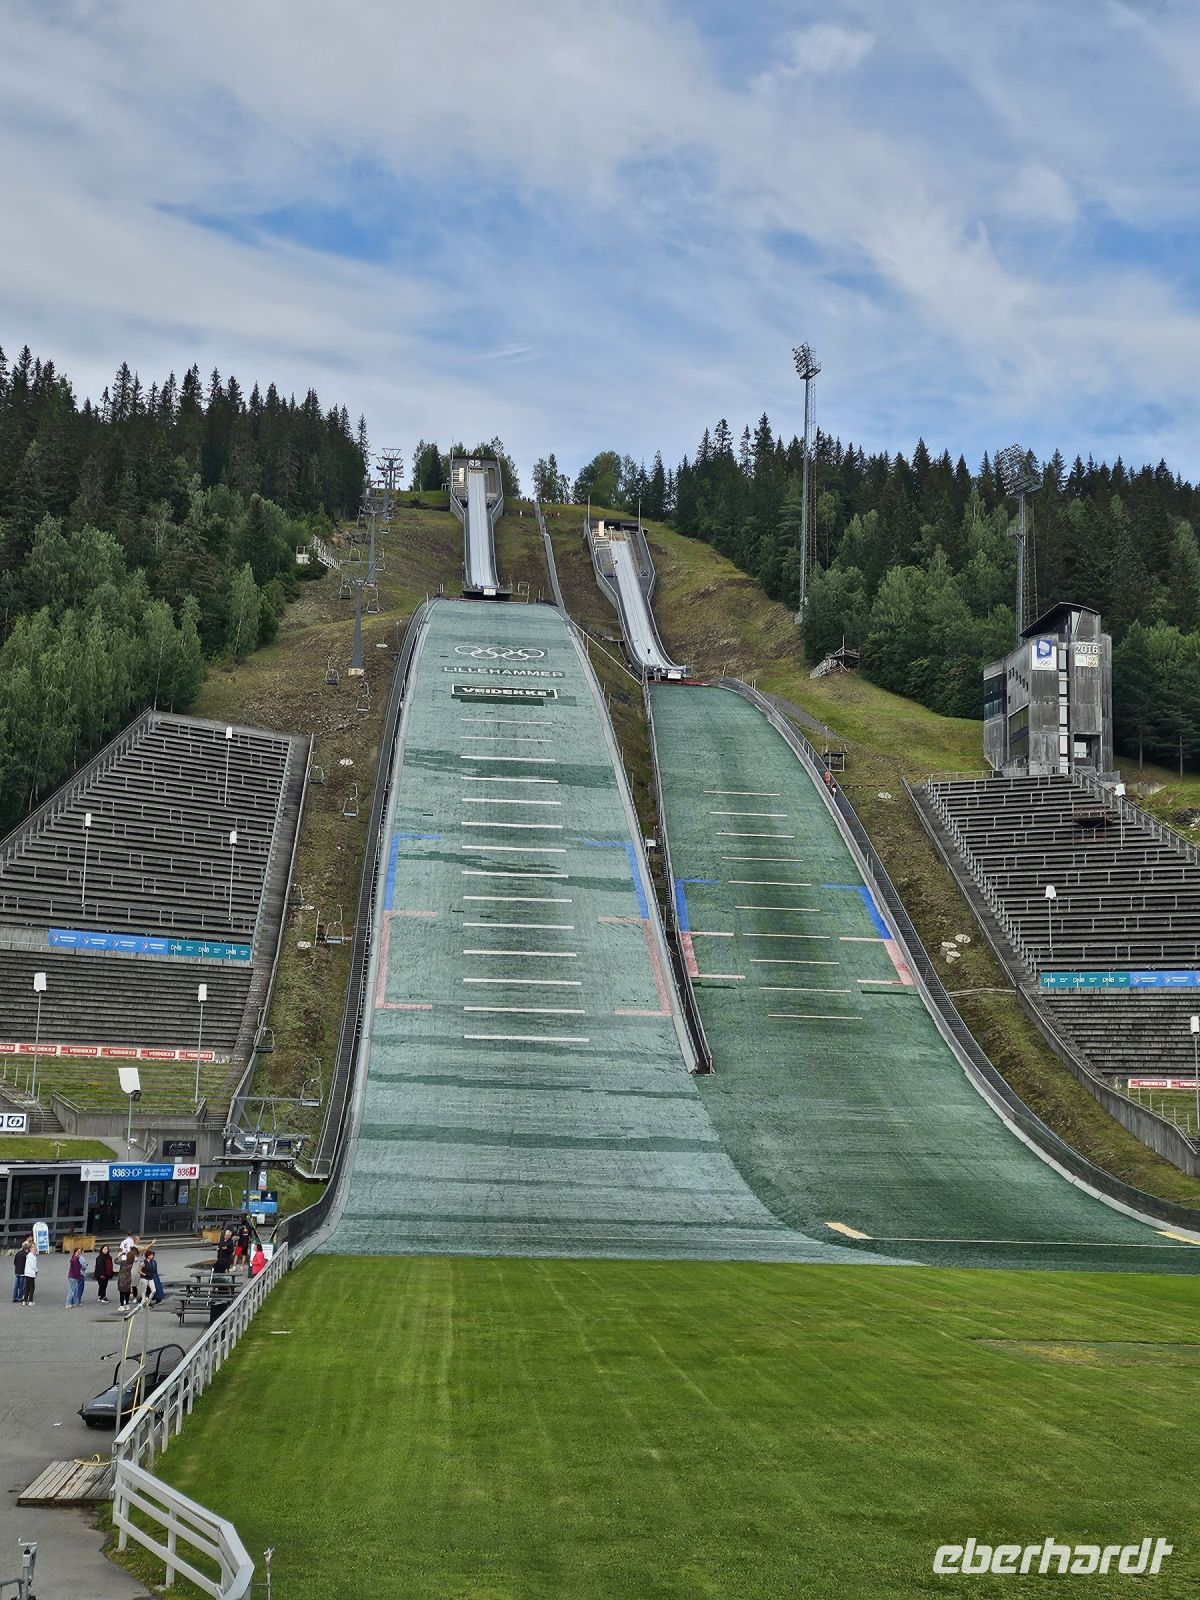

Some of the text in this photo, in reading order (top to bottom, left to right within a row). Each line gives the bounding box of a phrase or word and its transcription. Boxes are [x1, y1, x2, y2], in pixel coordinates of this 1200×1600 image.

[1075, 644, 1098, 654] 2016
[443, 666, 564, 678] LILLEHAMMER
[461, 687, 547, 697] VEIDEKKE
[177, 1169, 190, 1177] 936
